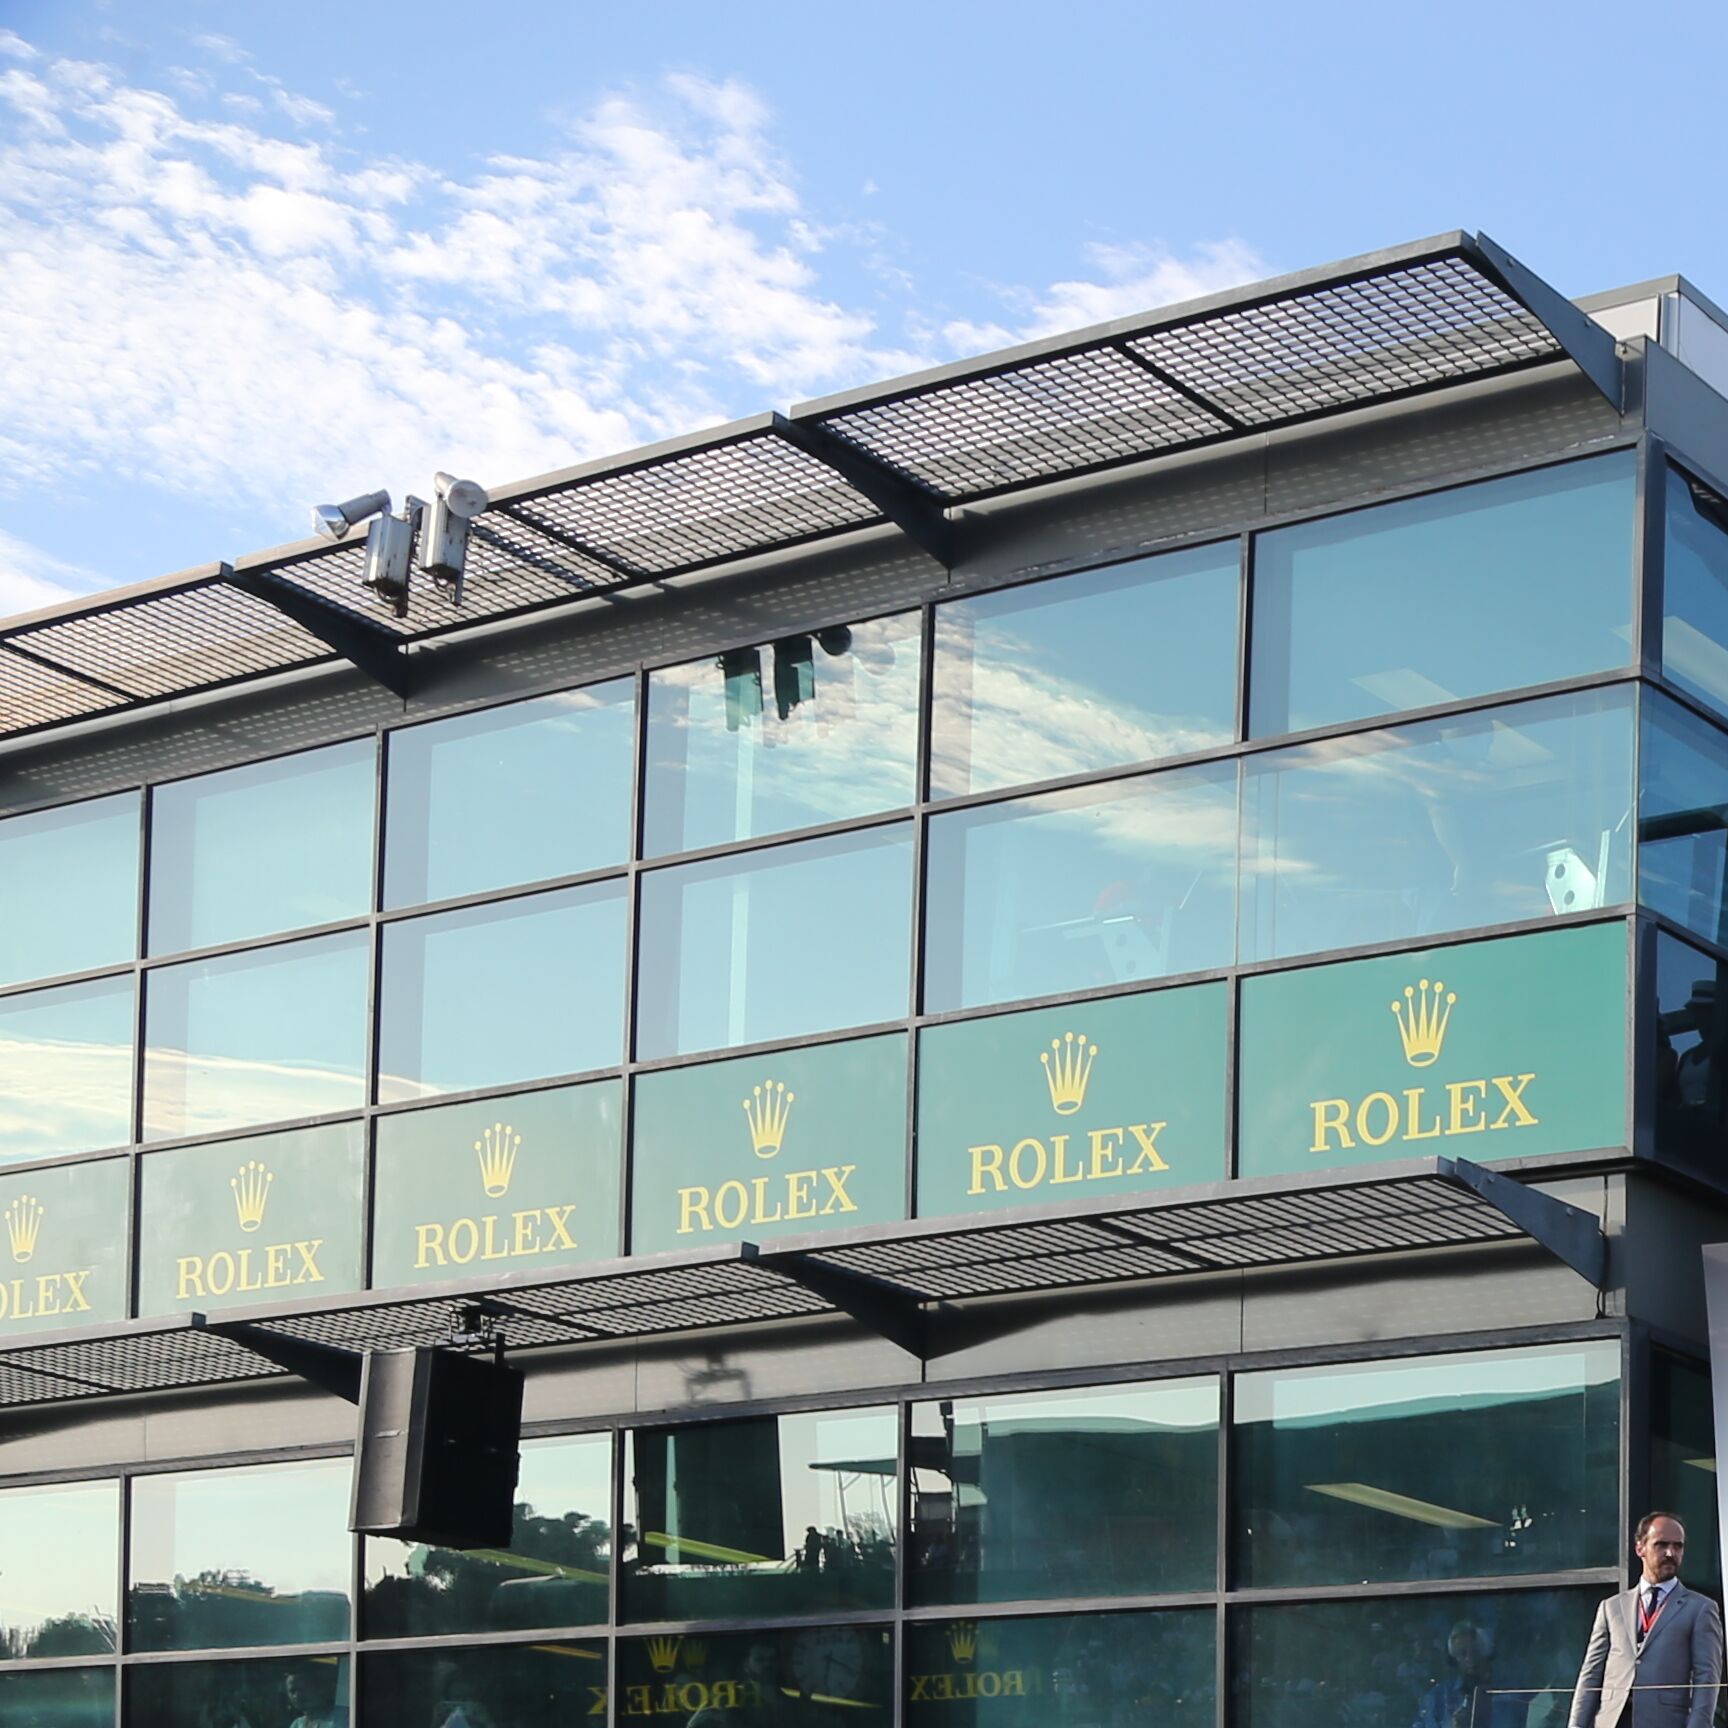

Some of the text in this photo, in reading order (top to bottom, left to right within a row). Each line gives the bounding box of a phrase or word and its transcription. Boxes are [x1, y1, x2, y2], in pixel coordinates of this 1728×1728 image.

[1309, 1073, 1539, 1153] ROLEX
[967, 1122, 1170, 1195] ROLEX
[676, 1164, 858, 1233] ROLEX
[176, 1239, 324, 1299] ROLEX
[413, 1204, 578, 1268] ROLEX
